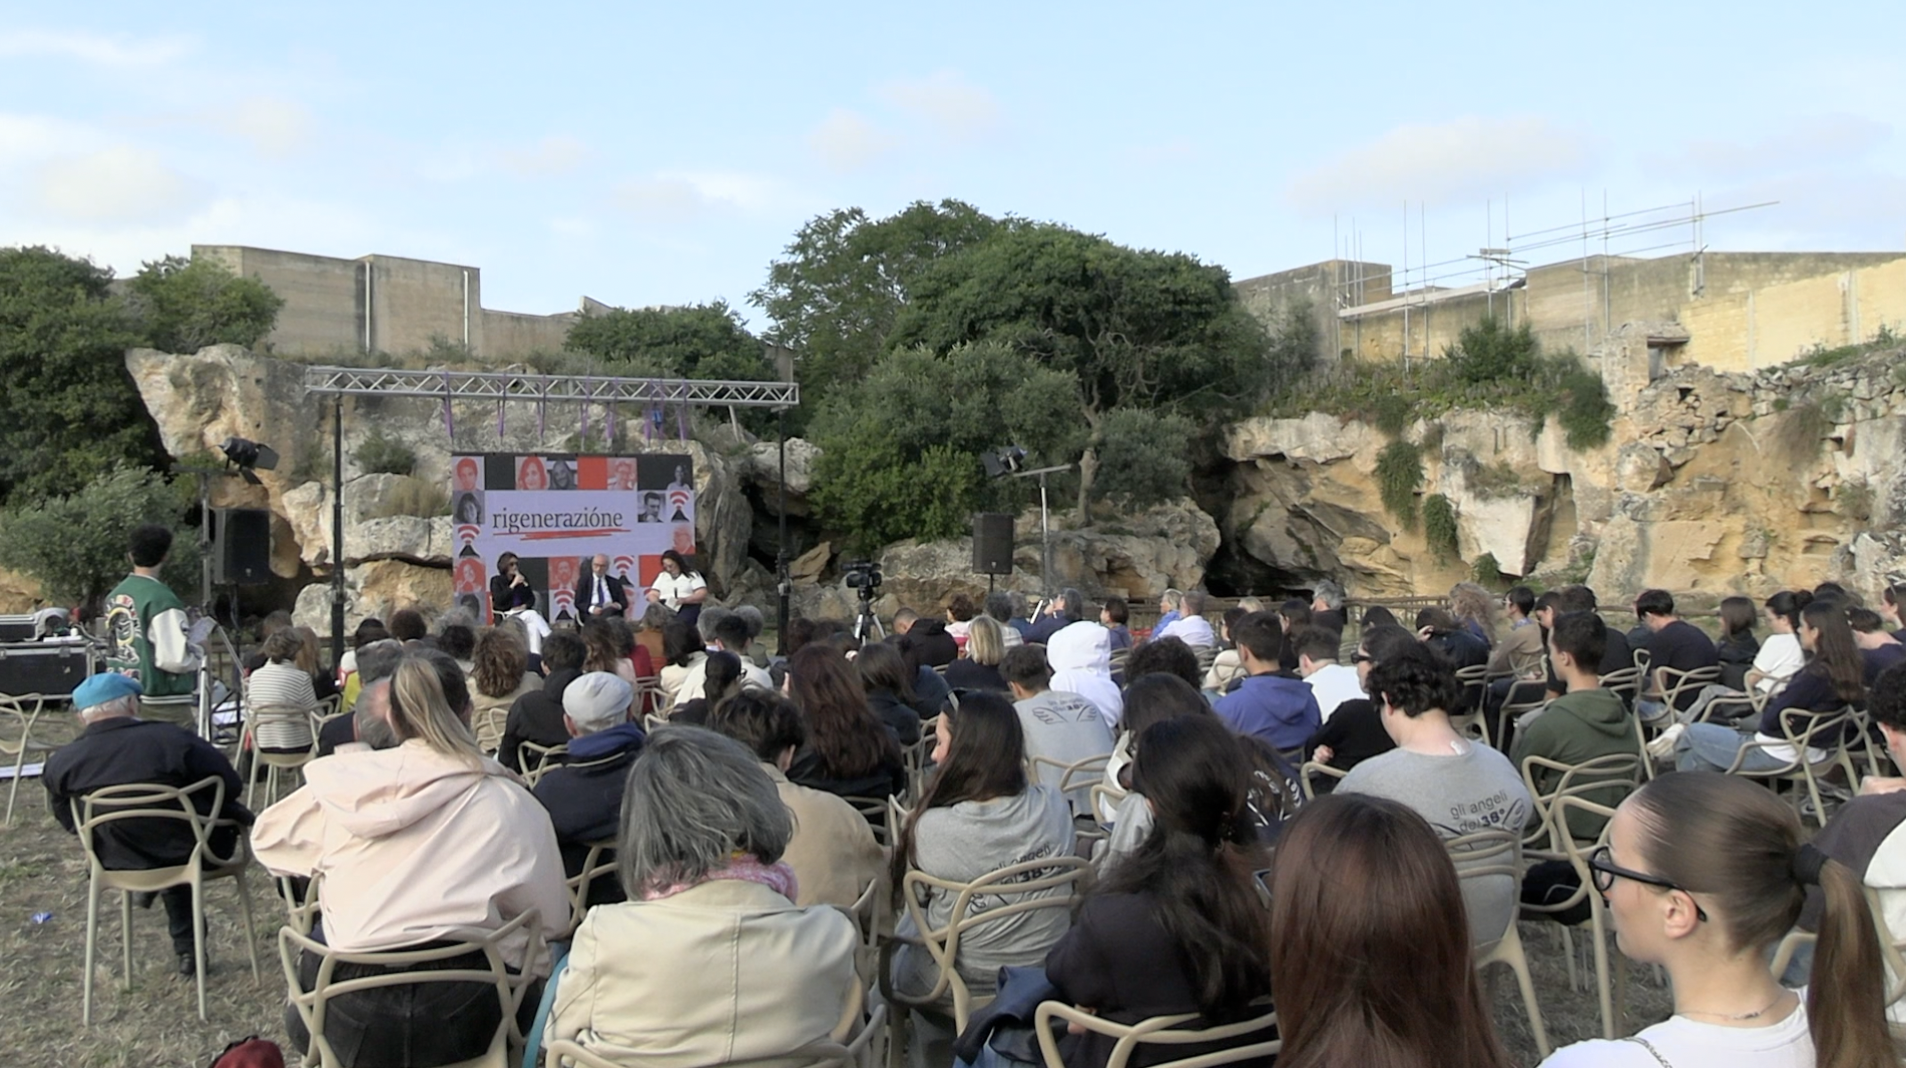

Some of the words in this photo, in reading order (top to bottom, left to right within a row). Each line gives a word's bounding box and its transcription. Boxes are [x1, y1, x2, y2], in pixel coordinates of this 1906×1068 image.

[492, 507, 623, 534] rigenerazióne
[1450, 803, 1466, 820] gli
[1470, 790, 1508, 814] angeli
